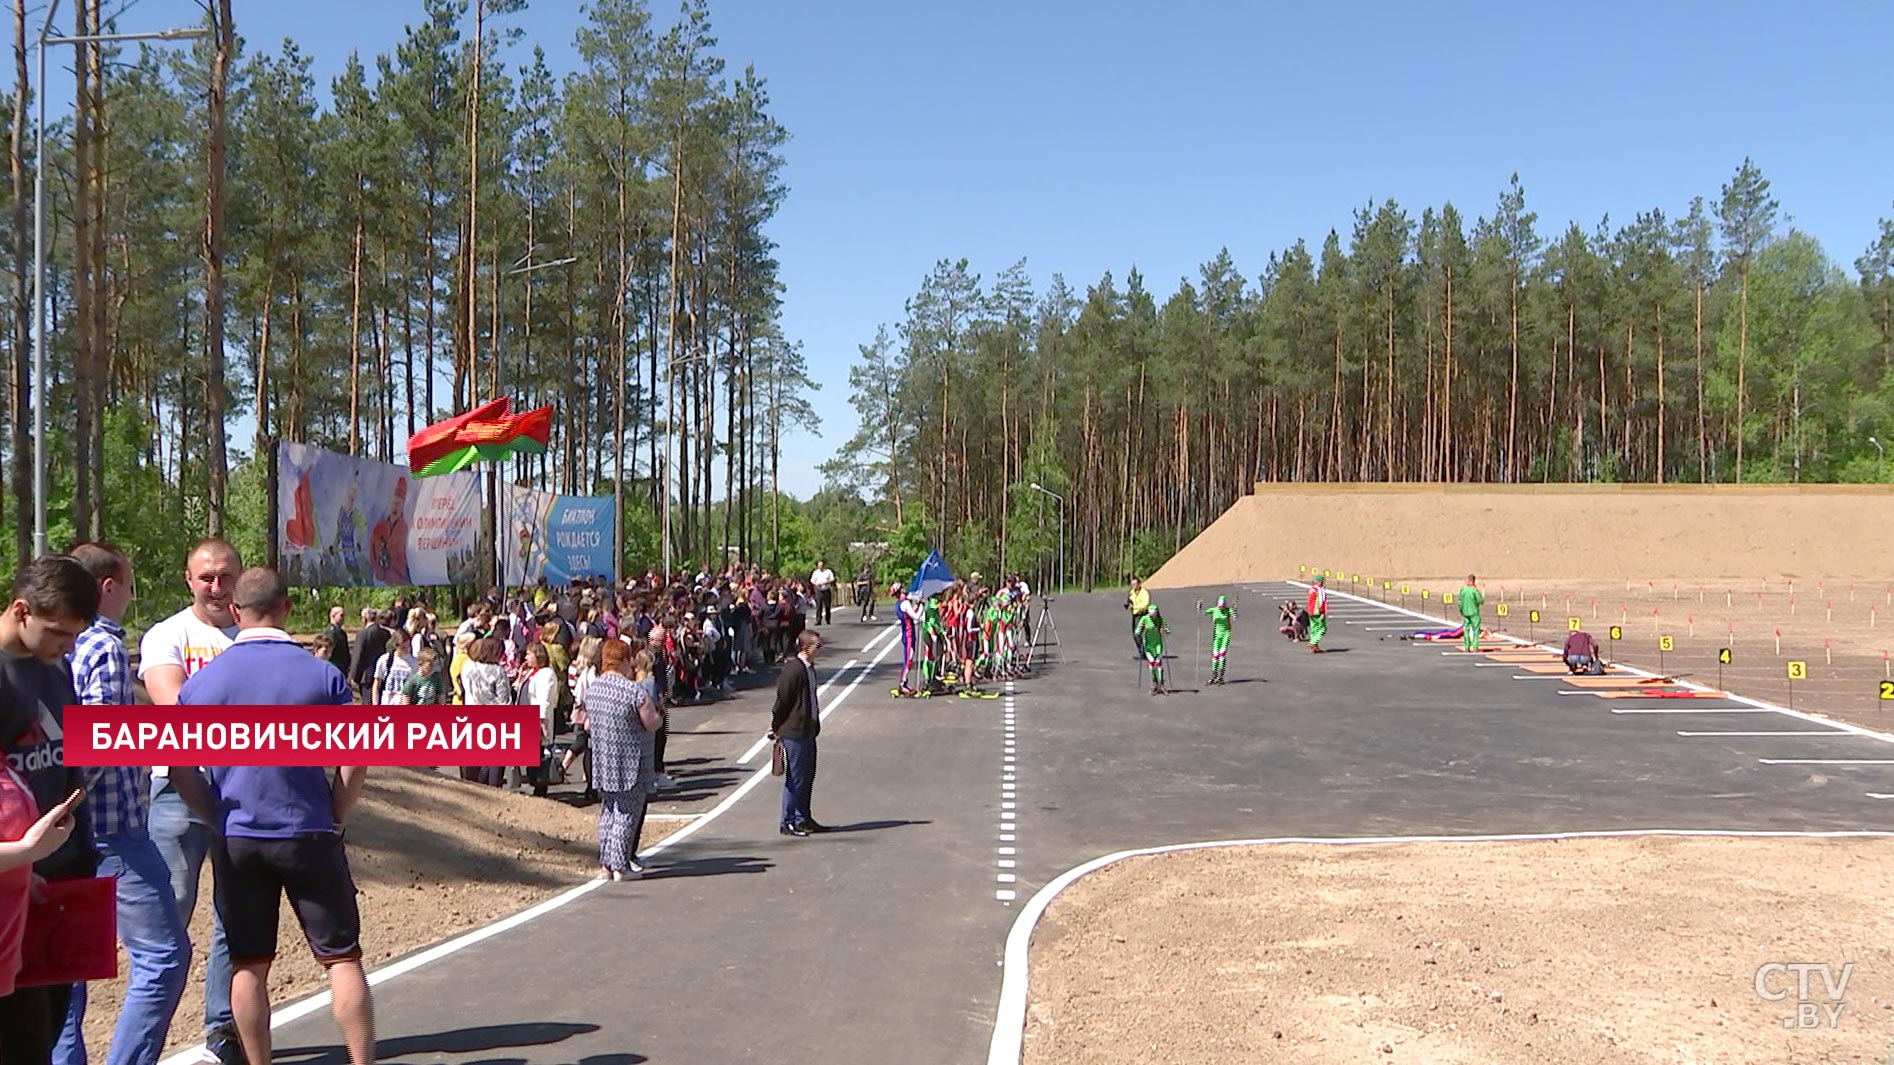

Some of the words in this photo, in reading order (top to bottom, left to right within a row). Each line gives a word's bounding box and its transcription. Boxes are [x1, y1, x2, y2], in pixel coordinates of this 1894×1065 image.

[556, 531, 601, 549] РОЖДАЕТСЯ
[1611, 627, 1621, 640] 6
[1720, 649, 1731, 664] 4
[1791, 663, 1802, 677] 3
[1880, 681, 1894, 700] 2
